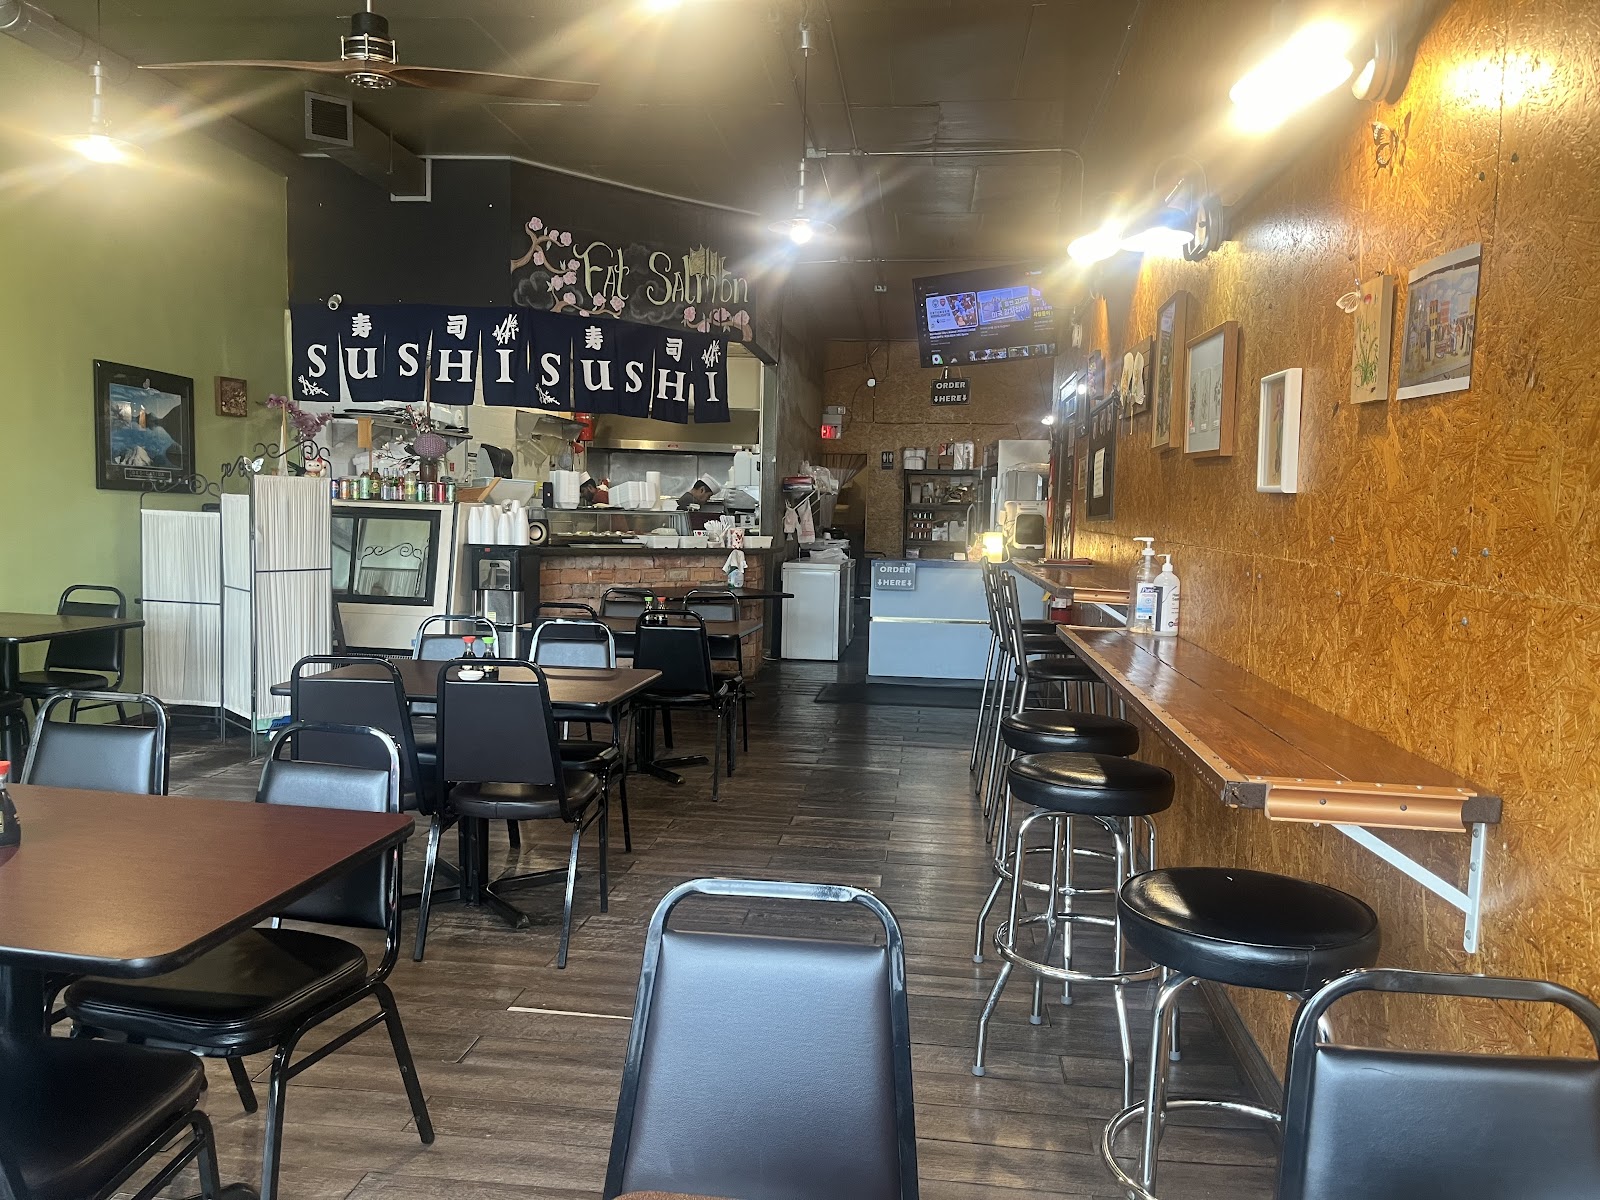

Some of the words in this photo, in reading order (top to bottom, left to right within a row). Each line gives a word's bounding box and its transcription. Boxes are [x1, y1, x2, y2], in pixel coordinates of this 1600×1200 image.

[307, 343, 515, 384] SUSHI
[540, 352, 719, 403] SUSHI
[936, 381, 966, 389] ORDER
[939, 394, 962, 402] HERE
[879, 566, 911, 574] ORDER
